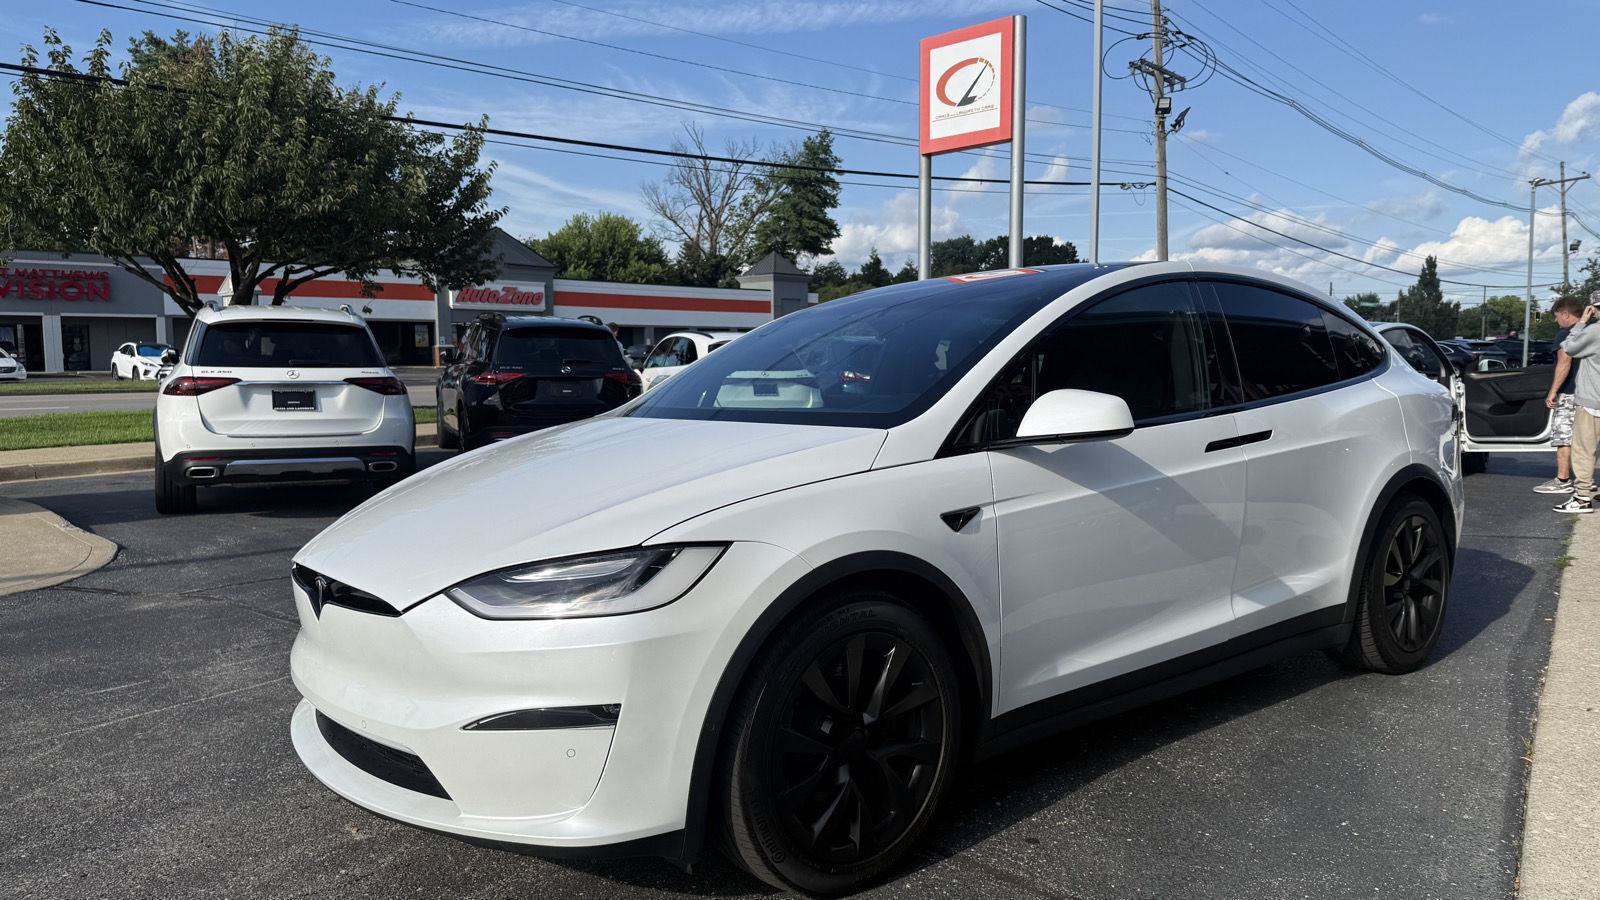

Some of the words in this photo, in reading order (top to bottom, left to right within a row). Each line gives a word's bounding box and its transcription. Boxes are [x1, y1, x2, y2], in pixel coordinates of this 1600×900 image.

[15, 268, 110, 280] MATTHEWS
[0, 279, 112, 302] VISION
[455, 285, 544, 305] AutoZone
